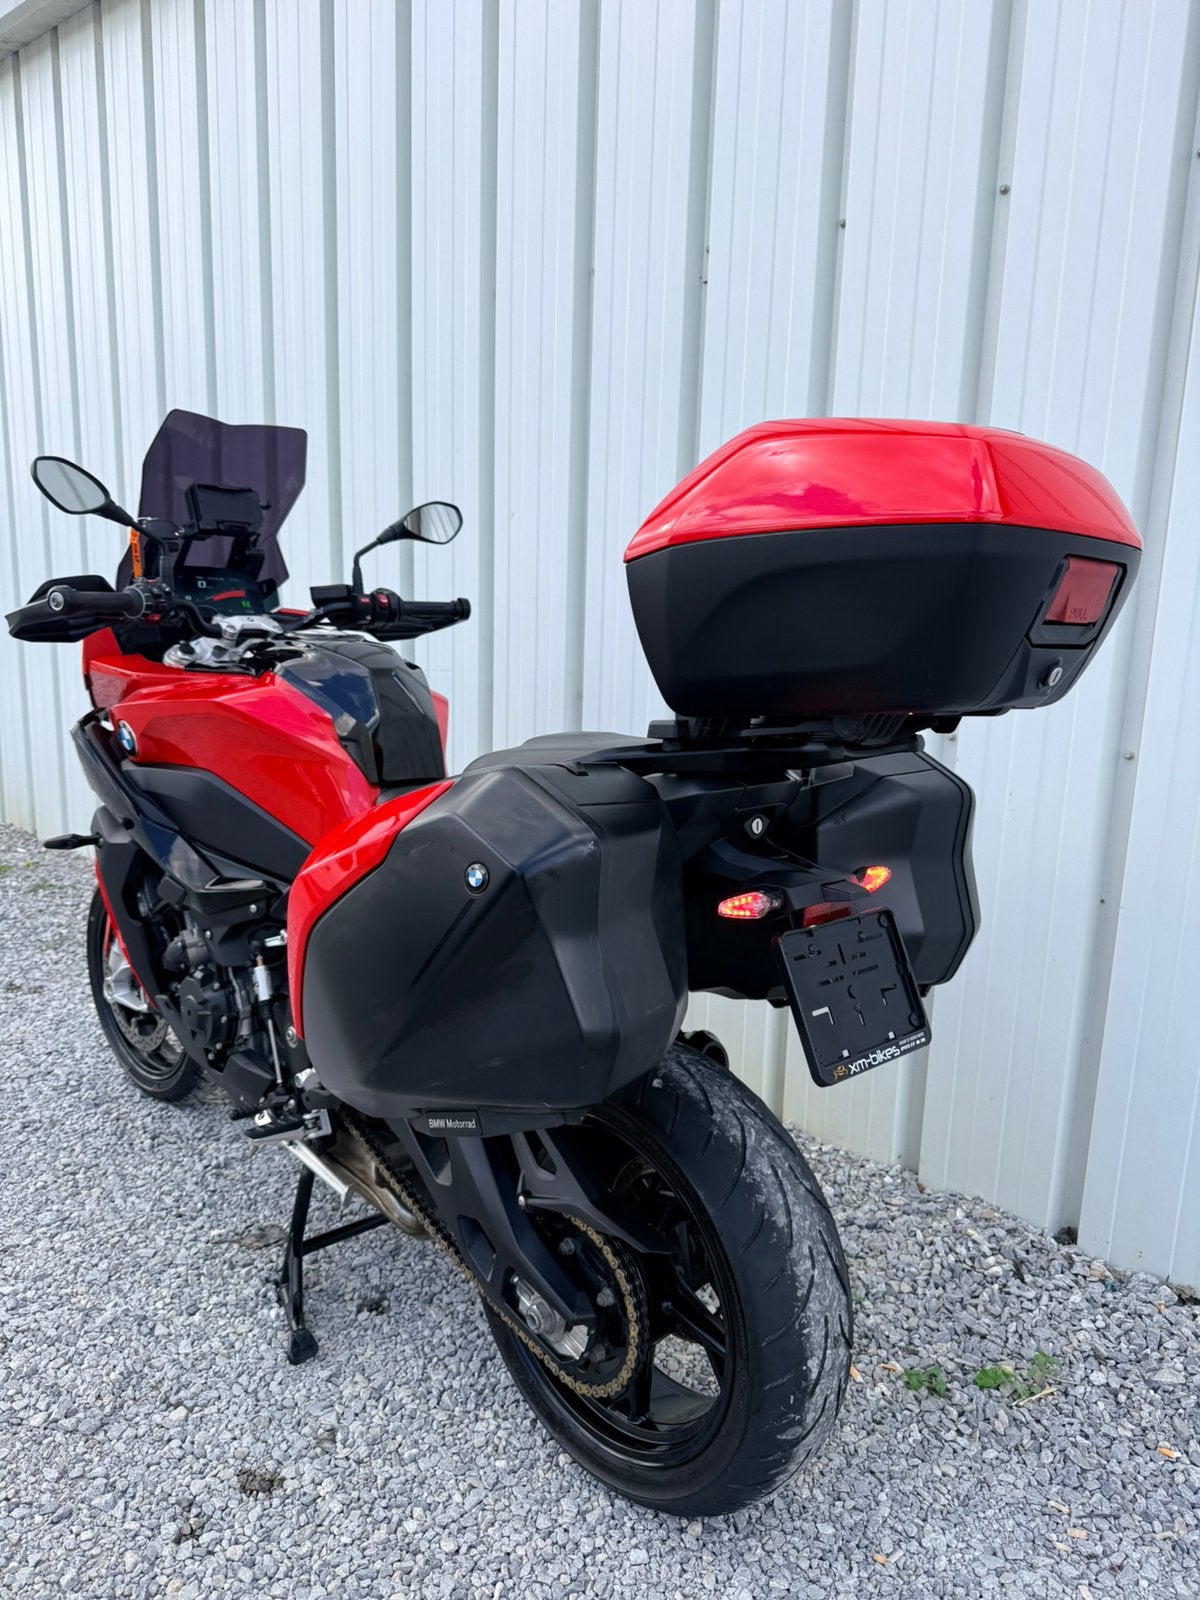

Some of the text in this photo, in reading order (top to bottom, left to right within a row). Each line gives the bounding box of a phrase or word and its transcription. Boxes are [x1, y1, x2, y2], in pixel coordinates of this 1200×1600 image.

[848, 1045, 901, 1075] xm-bikes
[428, 1118, 476, 1129] BMW Motorrad
